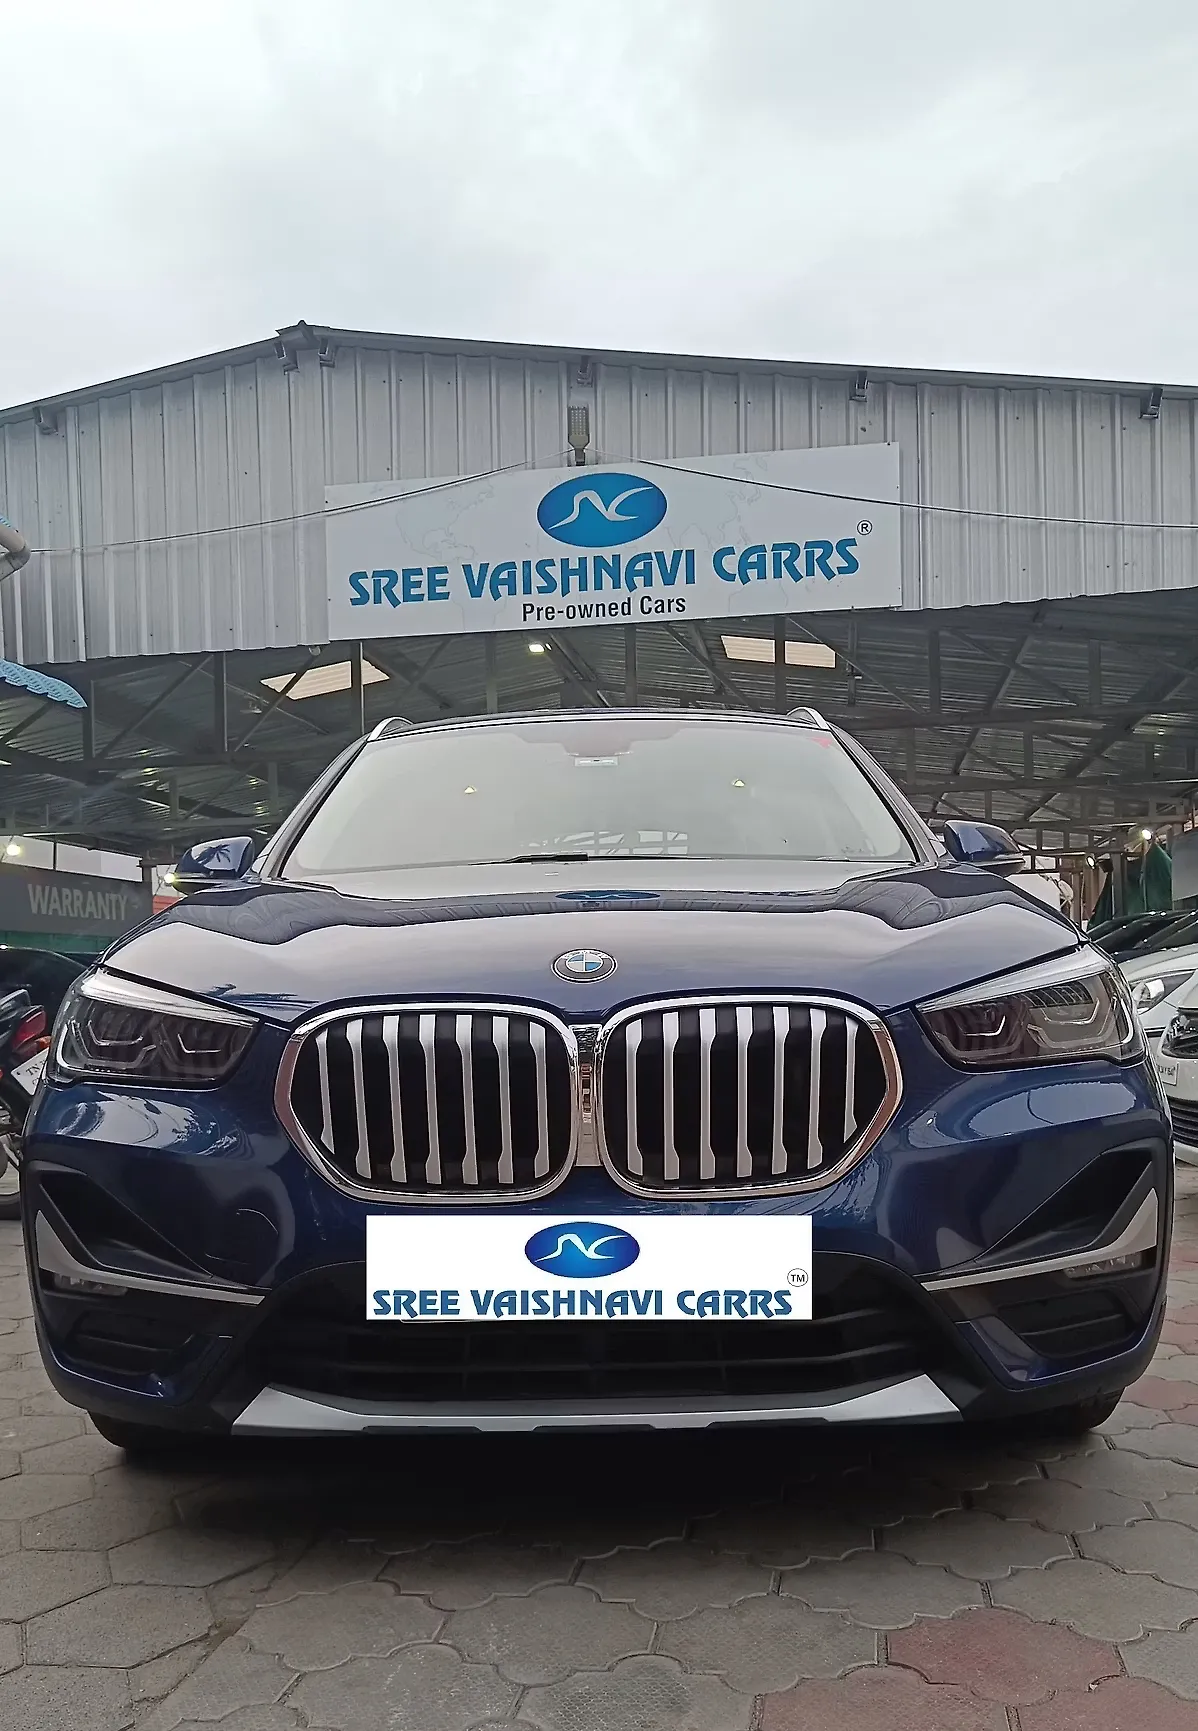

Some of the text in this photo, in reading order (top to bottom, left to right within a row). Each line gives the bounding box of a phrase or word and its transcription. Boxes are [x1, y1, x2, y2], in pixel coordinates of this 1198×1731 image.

[349, 537, 860, 609] SREE VAISHNAVI CARRS
[521, 593, 687, 623] Pre-owned Cars
[27, 883, 127, 920] WARRANTY
